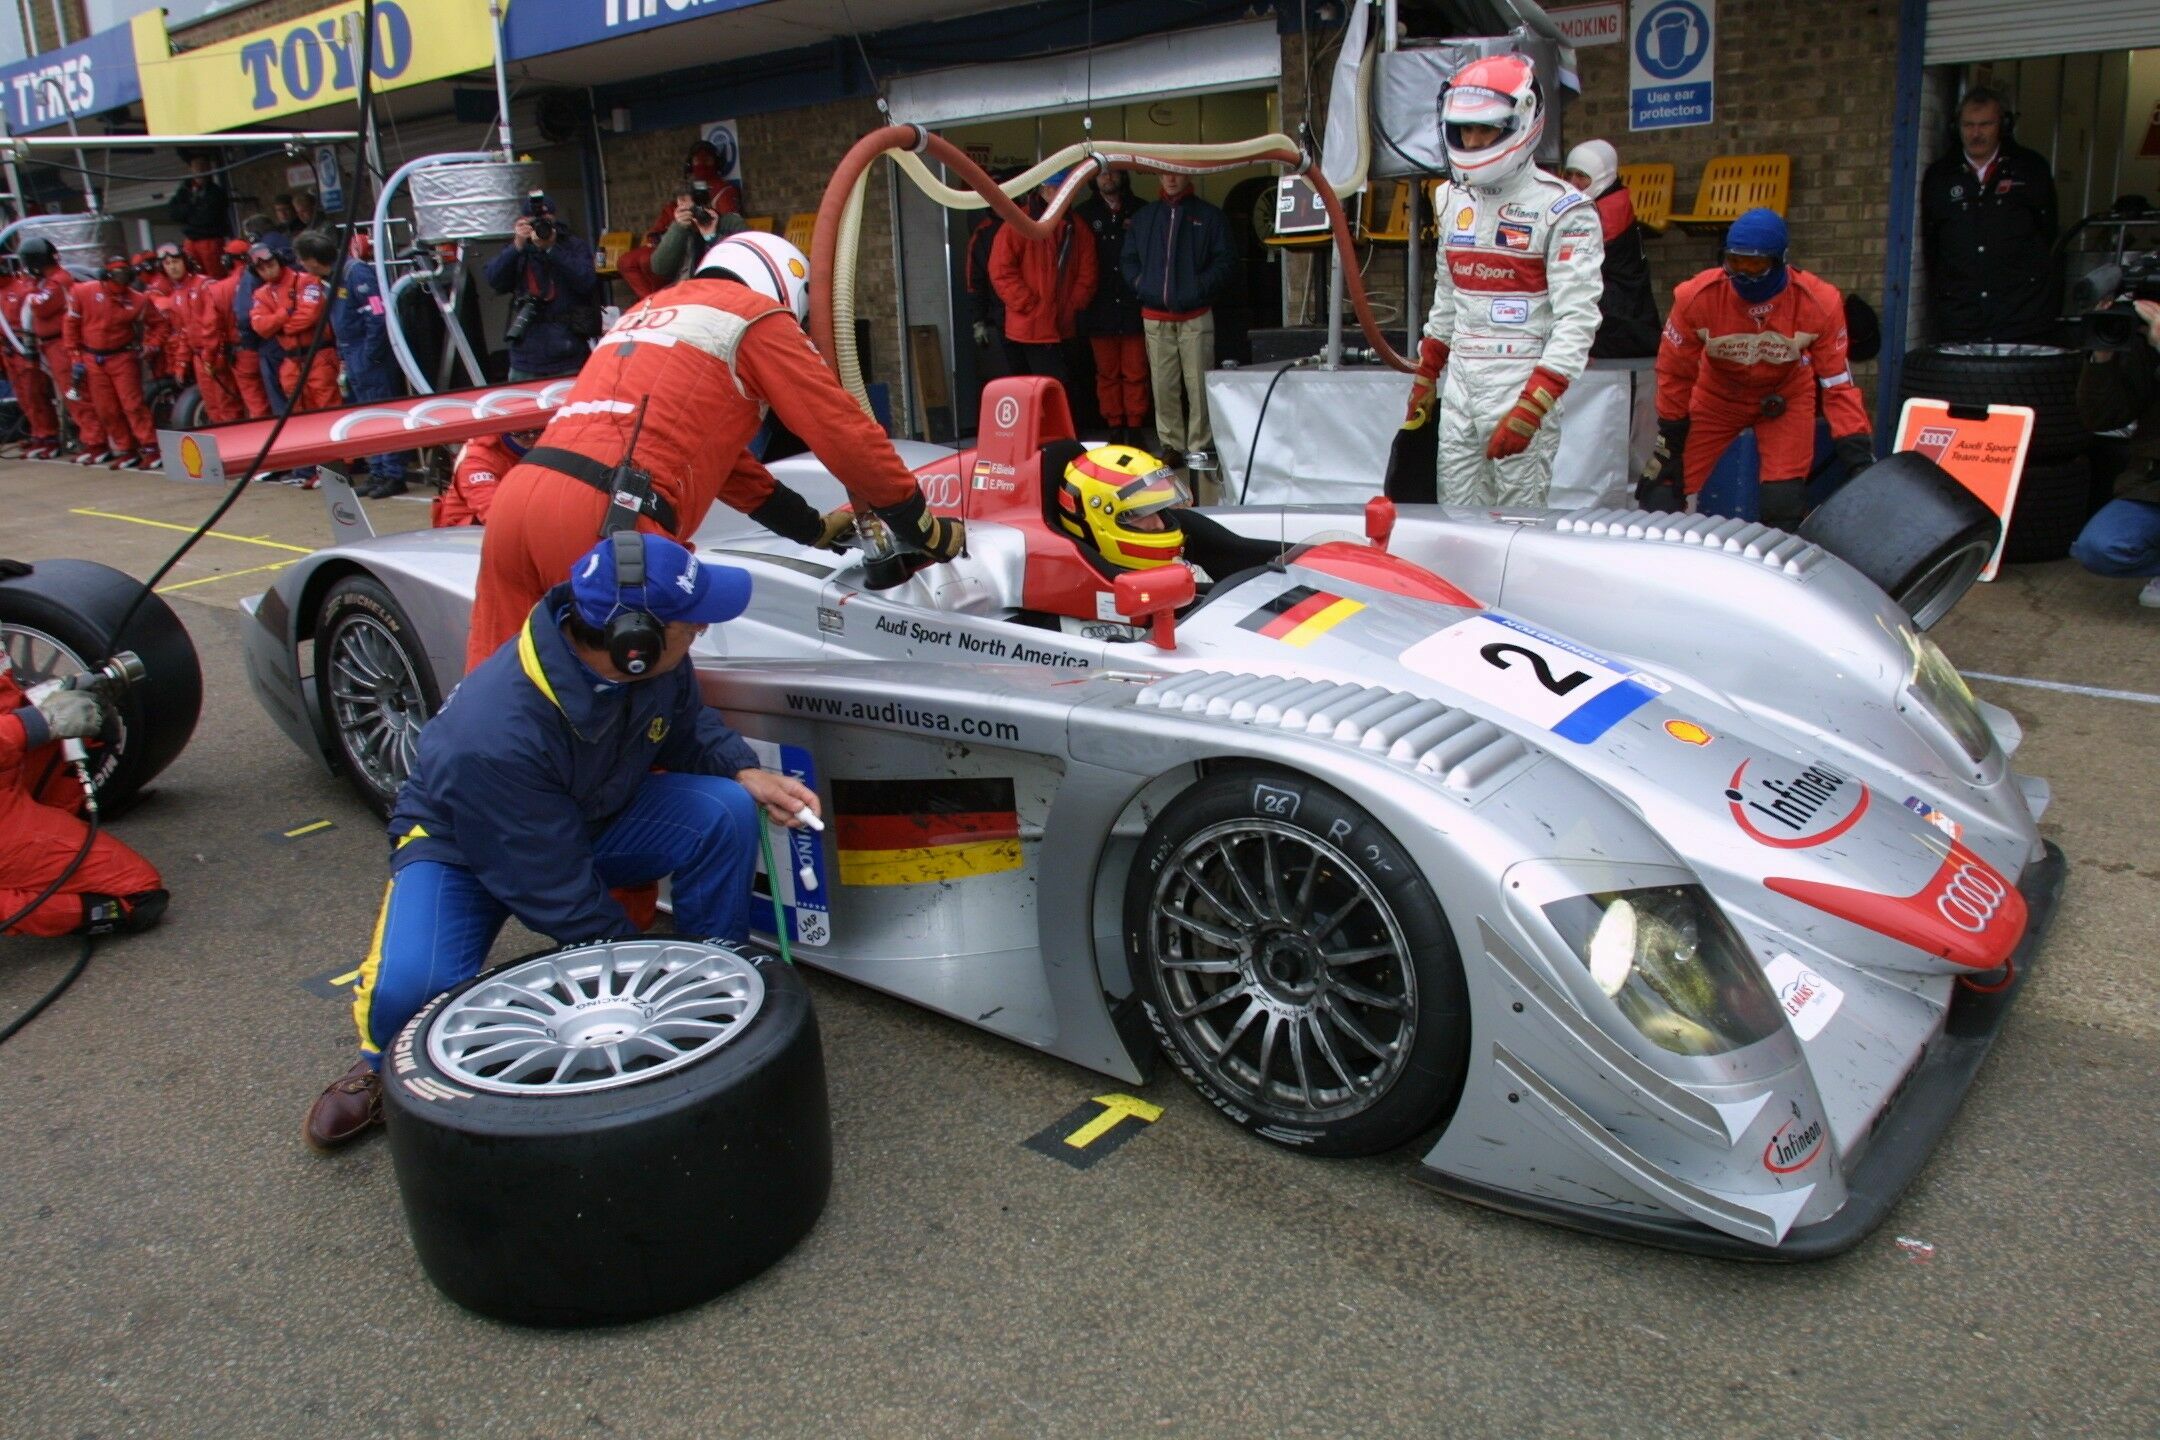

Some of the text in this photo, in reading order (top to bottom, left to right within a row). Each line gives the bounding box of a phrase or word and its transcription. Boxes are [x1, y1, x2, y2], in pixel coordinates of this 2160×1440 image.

[1556, 14, 1617, 37] MOKING
[241, 0, 412, 110] TOYO
[12, 54, 95, 126] TYRES
[1648, 89, 1696, 104] Use ear
[1639, 104, 1703, 122] protectors
[1453, 262, 1516, 281] Aud Sport
[1952, 451, 1978, 462] Team
[1956, 440, 2017, 452] Audi Sport
[875, 615, 1089, 668] Audi Sport North America
[1480, 642, 1594, 697] 2
[786, 693, 1020, 741] www.audiusa.com
[1264, 795, 1290, 814] 26
[1326, 818, 1352, 847] R
[799, 913, 818, 934] LMP
[805, 926, 827, 944] 900
[393, 992, 449, 1075] MICHELIN
[1776, 1119, 1822, 1165] Infineon
